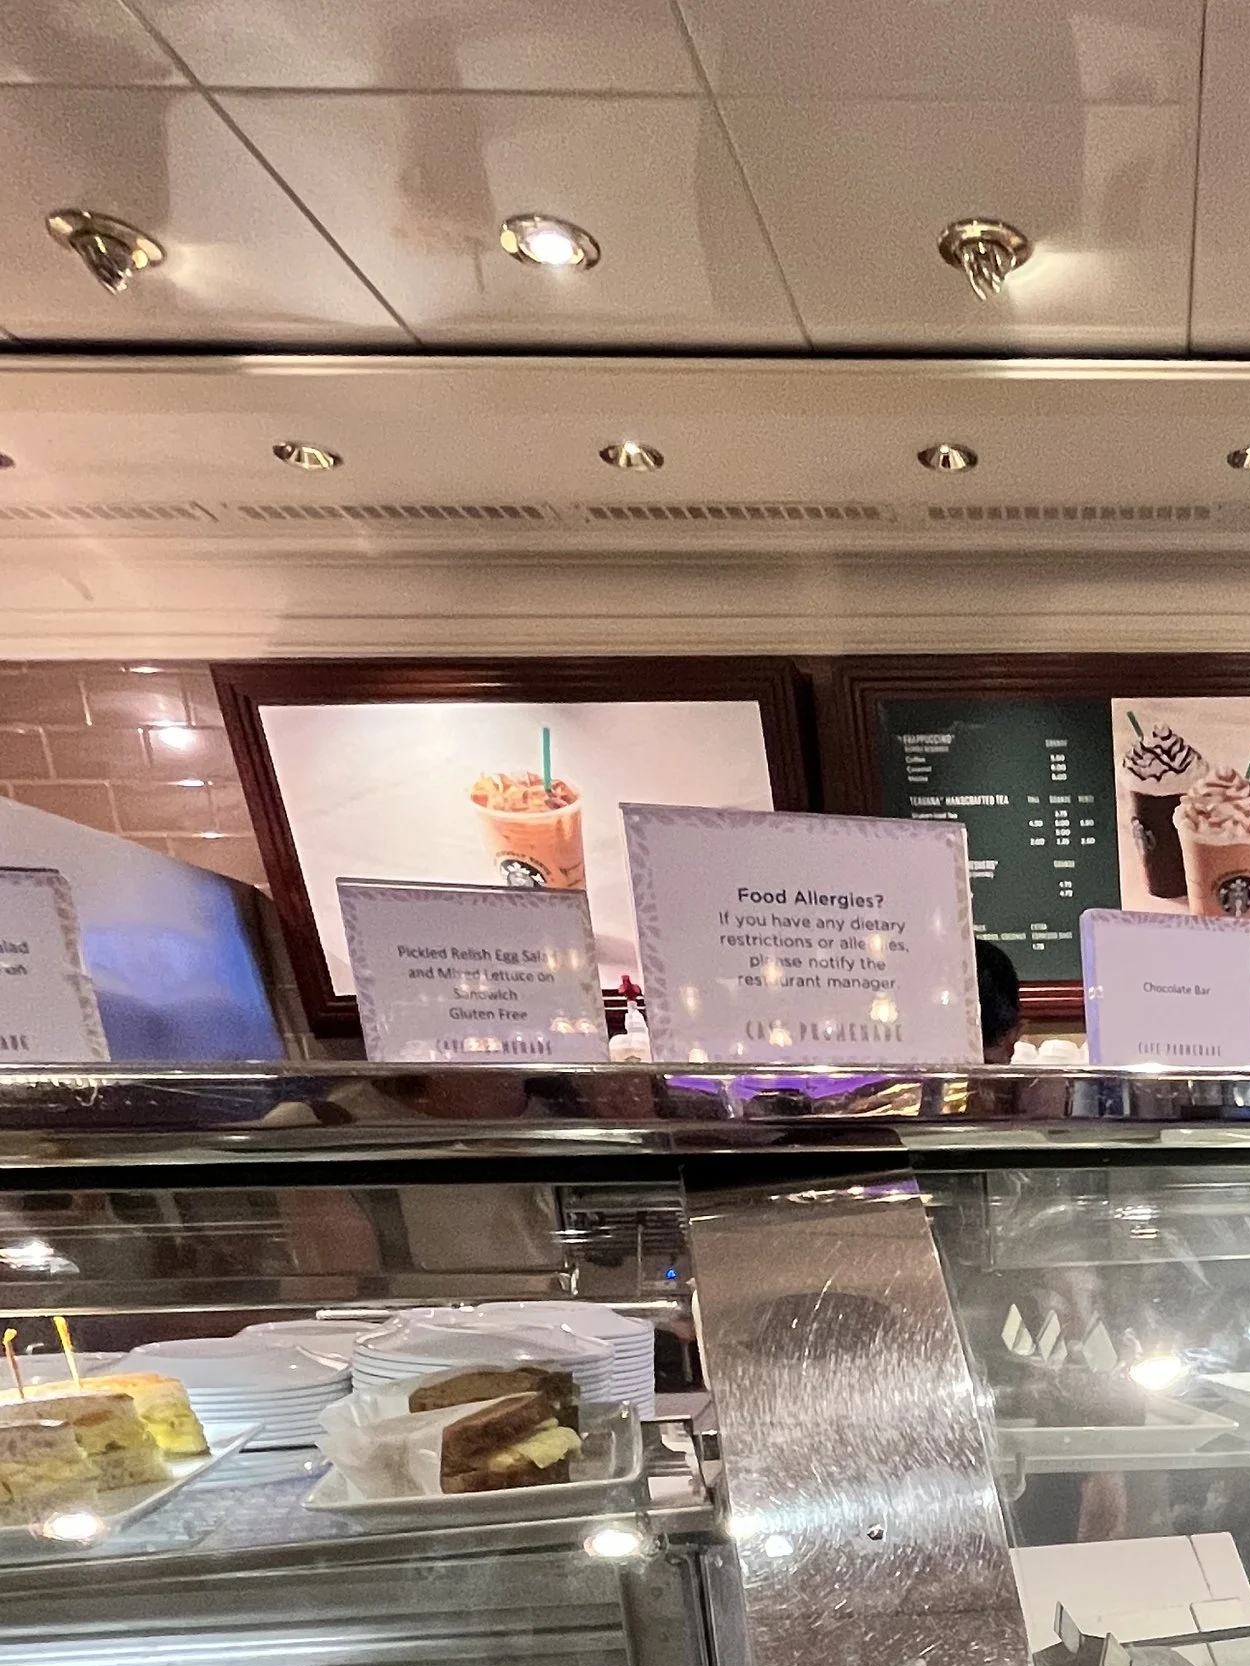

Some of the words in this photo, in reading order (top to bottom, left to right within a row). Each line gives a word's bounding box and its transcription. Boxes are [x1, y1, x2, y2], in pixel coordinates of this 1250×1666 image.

[738, 887, 787, 904] Food
[794, 890, 884, 910] Allergies?
[719, 912, 729, 925] If
[735, 914, 767, 929] you
[771, 913, 811, 929] have
[816, 917, 845, 932] any
[850, 915, 906, 934] dietary
[720, 934, 813, 949] restrictions
[817, 937, 834, 949] or
[397, 945, 447, 960] Pickled
[451, 947, 492, 961] Relish
[495, 948, 519, 964] Egg
[808, 956, 855, 972] notify
[860, 957, 886, 971] the
[409, 967, 433, 979] and
[537, 973, 555, 982] on
[1143, 981, 1192, 994] Chocolate
[1194, 985, 1211, 995] Bar
[449, 1007, 495, 1021] Gluten
[499, 1008, 528, 1021] Free
[1166, 1043, 1222, 1056] PROMENADE
